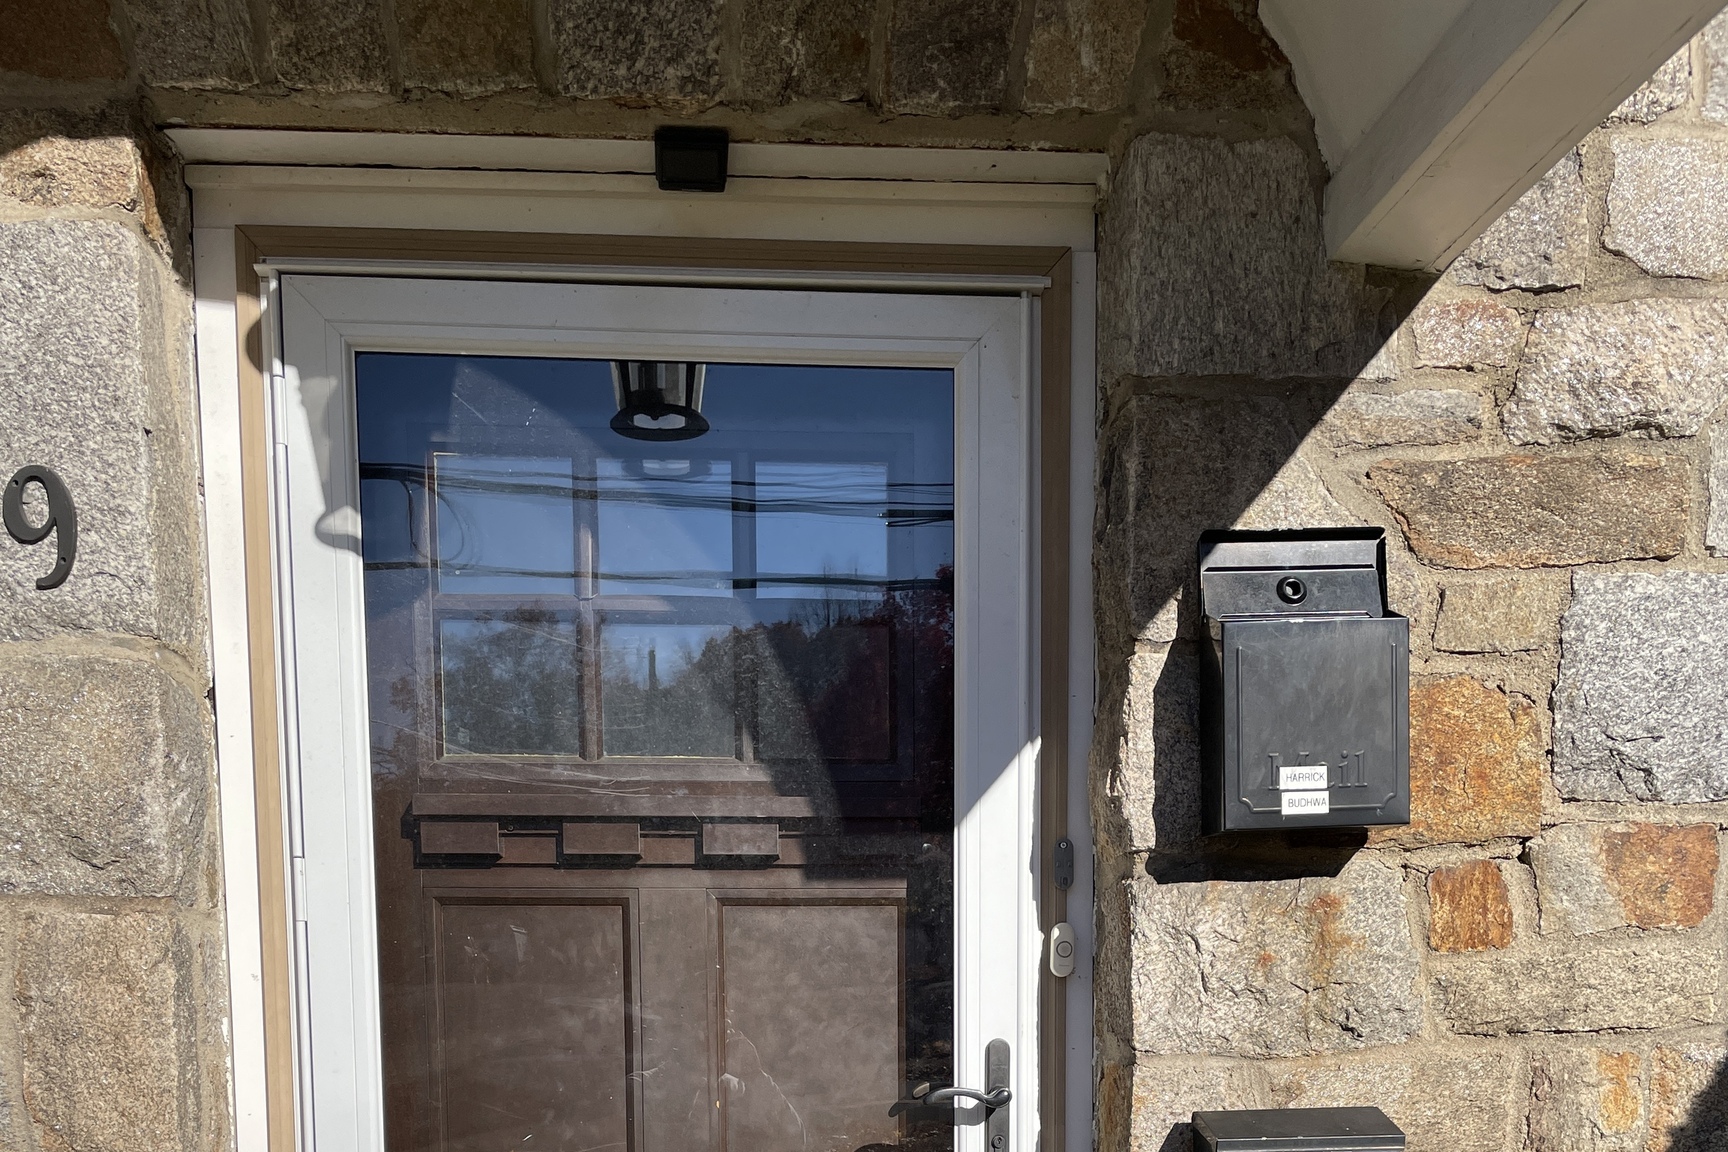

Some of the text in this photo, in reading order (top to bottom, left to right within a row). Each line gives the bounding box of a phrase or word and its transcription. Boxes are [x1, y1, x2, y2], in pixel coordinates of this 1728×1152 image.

[3, 465, 78, 590] 9
[1285, 771, 1326, 783] HARRICK
[1287, 797, 1327, 808] BUDHWA
